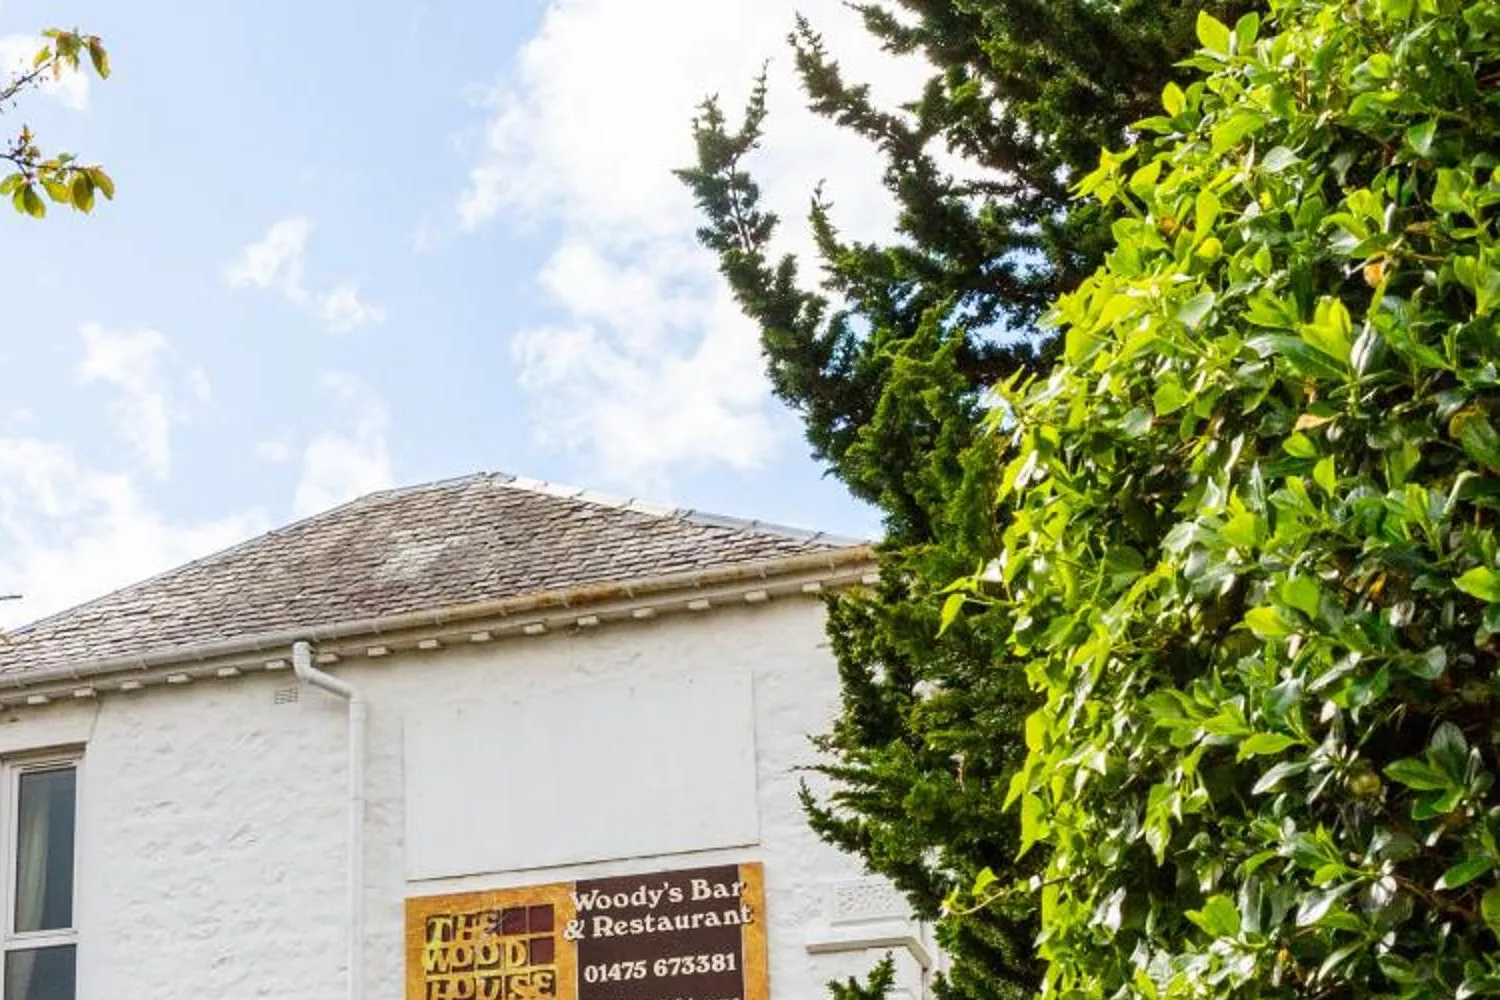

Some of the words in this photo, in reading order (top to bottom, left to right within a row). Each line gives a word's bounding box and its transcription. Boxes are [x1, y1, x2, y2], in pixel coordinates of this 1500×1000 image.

[570, 882, 683, 912] Woody's
[691, 879, 746, 901] Bar
[426, 911, 501, 943] THE
[564, 919, 585, 940] &
[593, 904, 754, 937] Restaurant
[423, 938, 527, 974] WOOD
[584, 958, 647, 983] 01475
[654, 952, 737, 977] 673381
